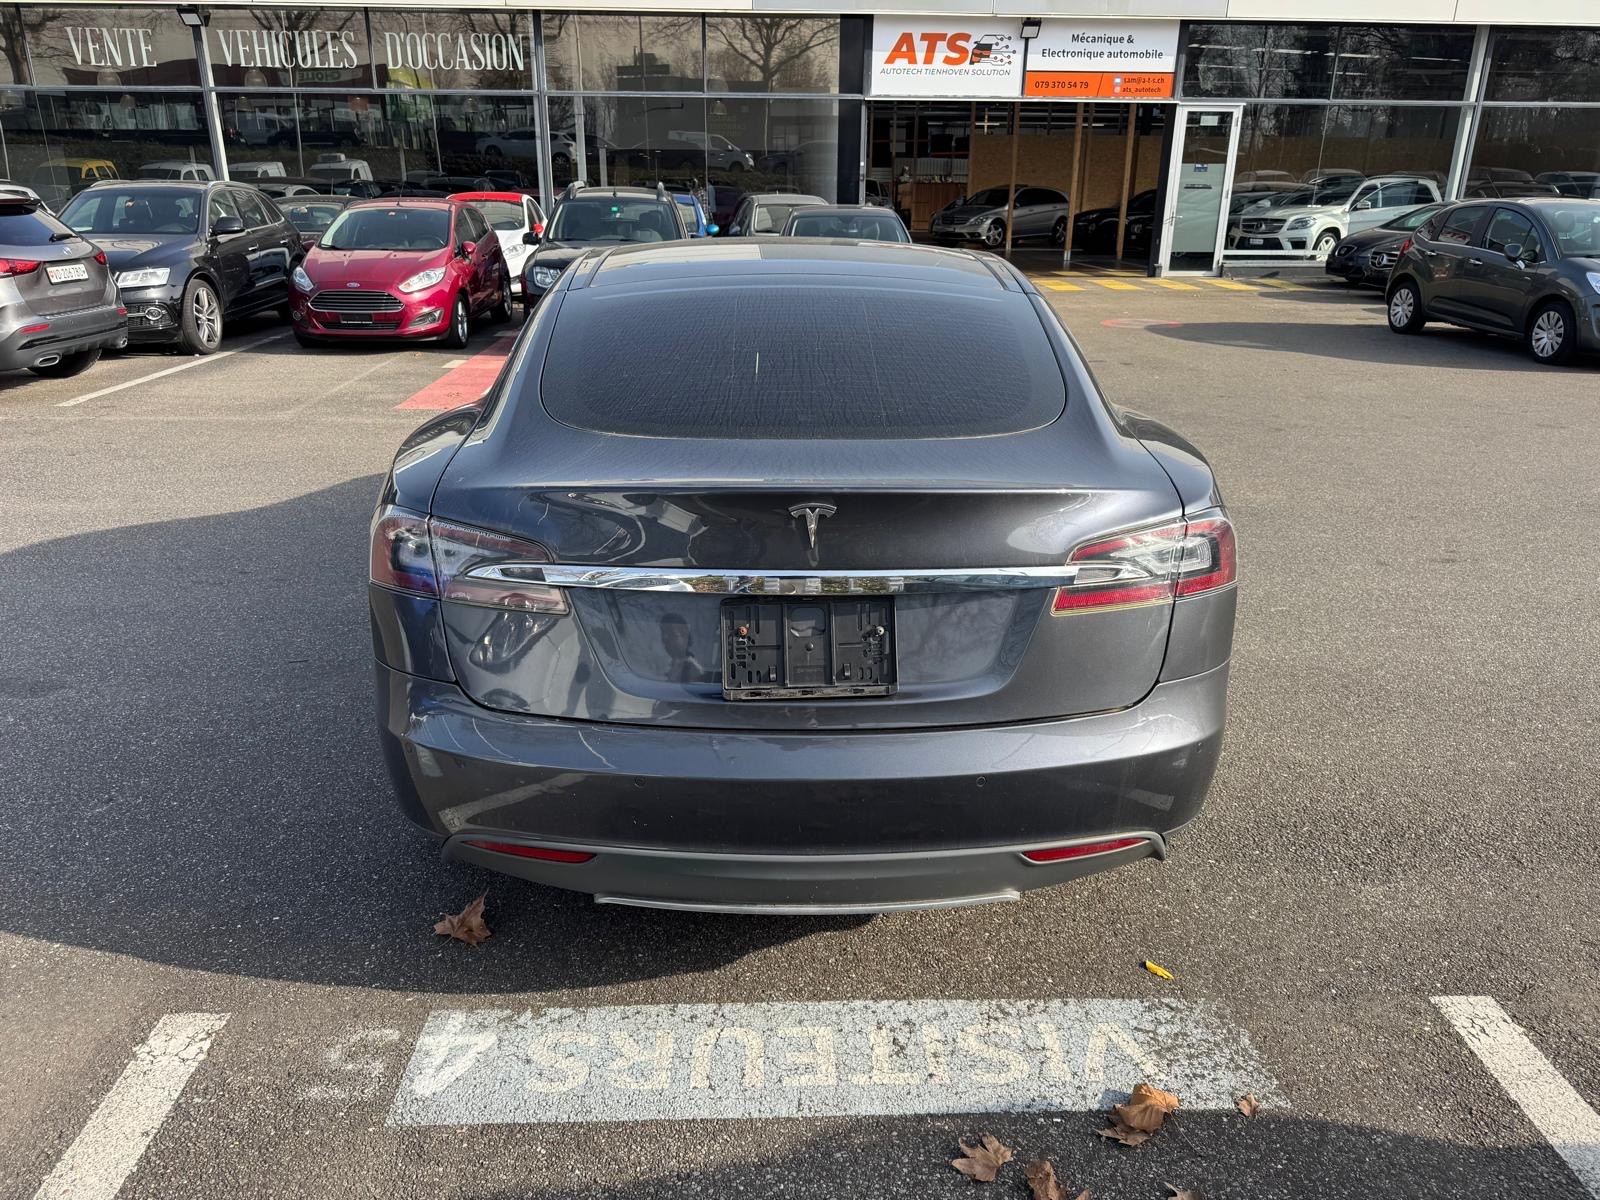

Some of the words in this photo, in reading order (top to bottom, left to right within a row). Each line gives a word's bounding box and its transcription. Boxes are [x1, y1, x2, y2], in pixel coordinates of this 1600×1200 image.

[1071, 32, 1125, 46] Mécanique
[1126, 34, 1135, 44] &
[64, 26, 157, 68] VENTE
[216, 29, 358, 70] VEHICULES
[384, 31, 525, 71] D'OCCASION
[884, 32, 972, 66] ATS
[1041, 48, 1105, 60] Electronique
[1107, 49, 1164, 59] automobile
[880, 67, 923, 75] AUTOTECH
[924, 68, 970, 76] TIENHOVEN
[971, 68, 1011, 76] SOLUTION
[1034, 81, 1050, 89] 079
[1051, 81, 1067, 89] 370
[1068, 81, 1078, 89] 54
[1079, 81, 1089, 89] 79
[523, 1021, 1167, 1094] VISITEURS
